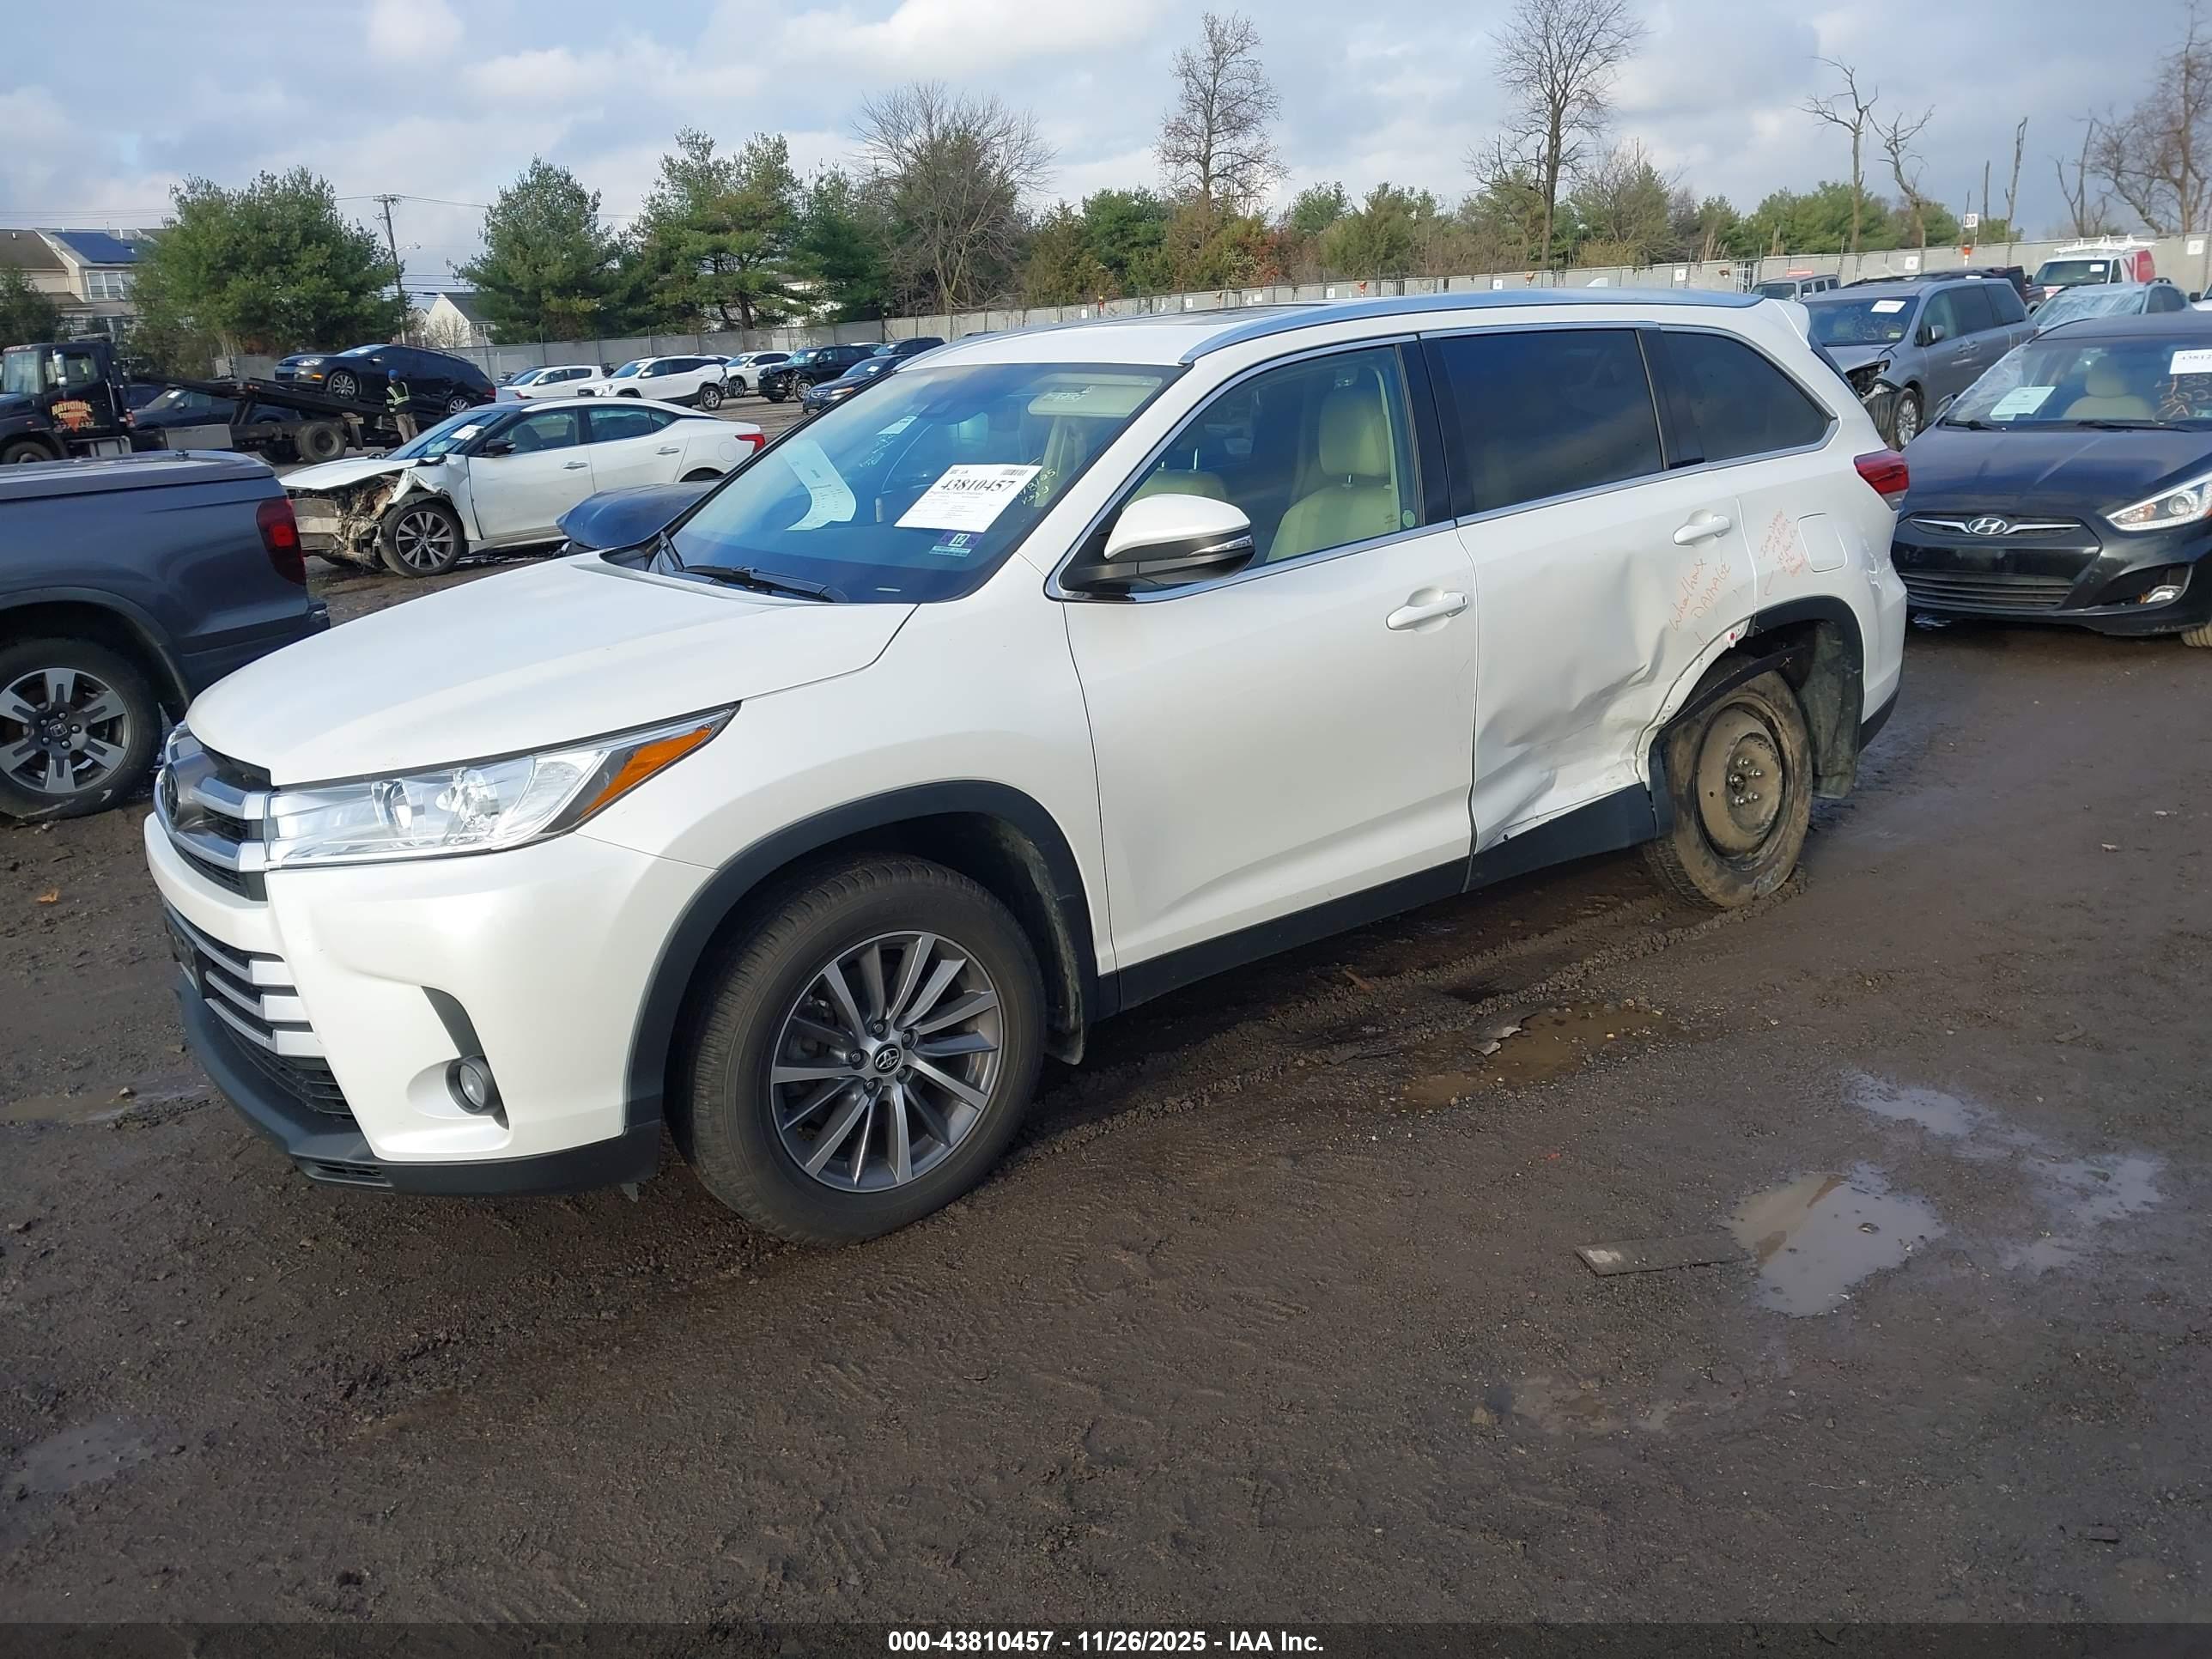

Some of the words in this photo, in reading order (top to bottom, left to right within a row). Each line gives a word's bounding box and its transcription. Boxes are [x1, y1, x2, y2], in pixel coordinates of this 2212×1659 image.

[51, 400, 93, 416] NATIONAL
[940, 480, 1018, 493] 43810457
[951, 533, 969, 545] 12
[1690, 562, 1732, 619] DAMAGE
